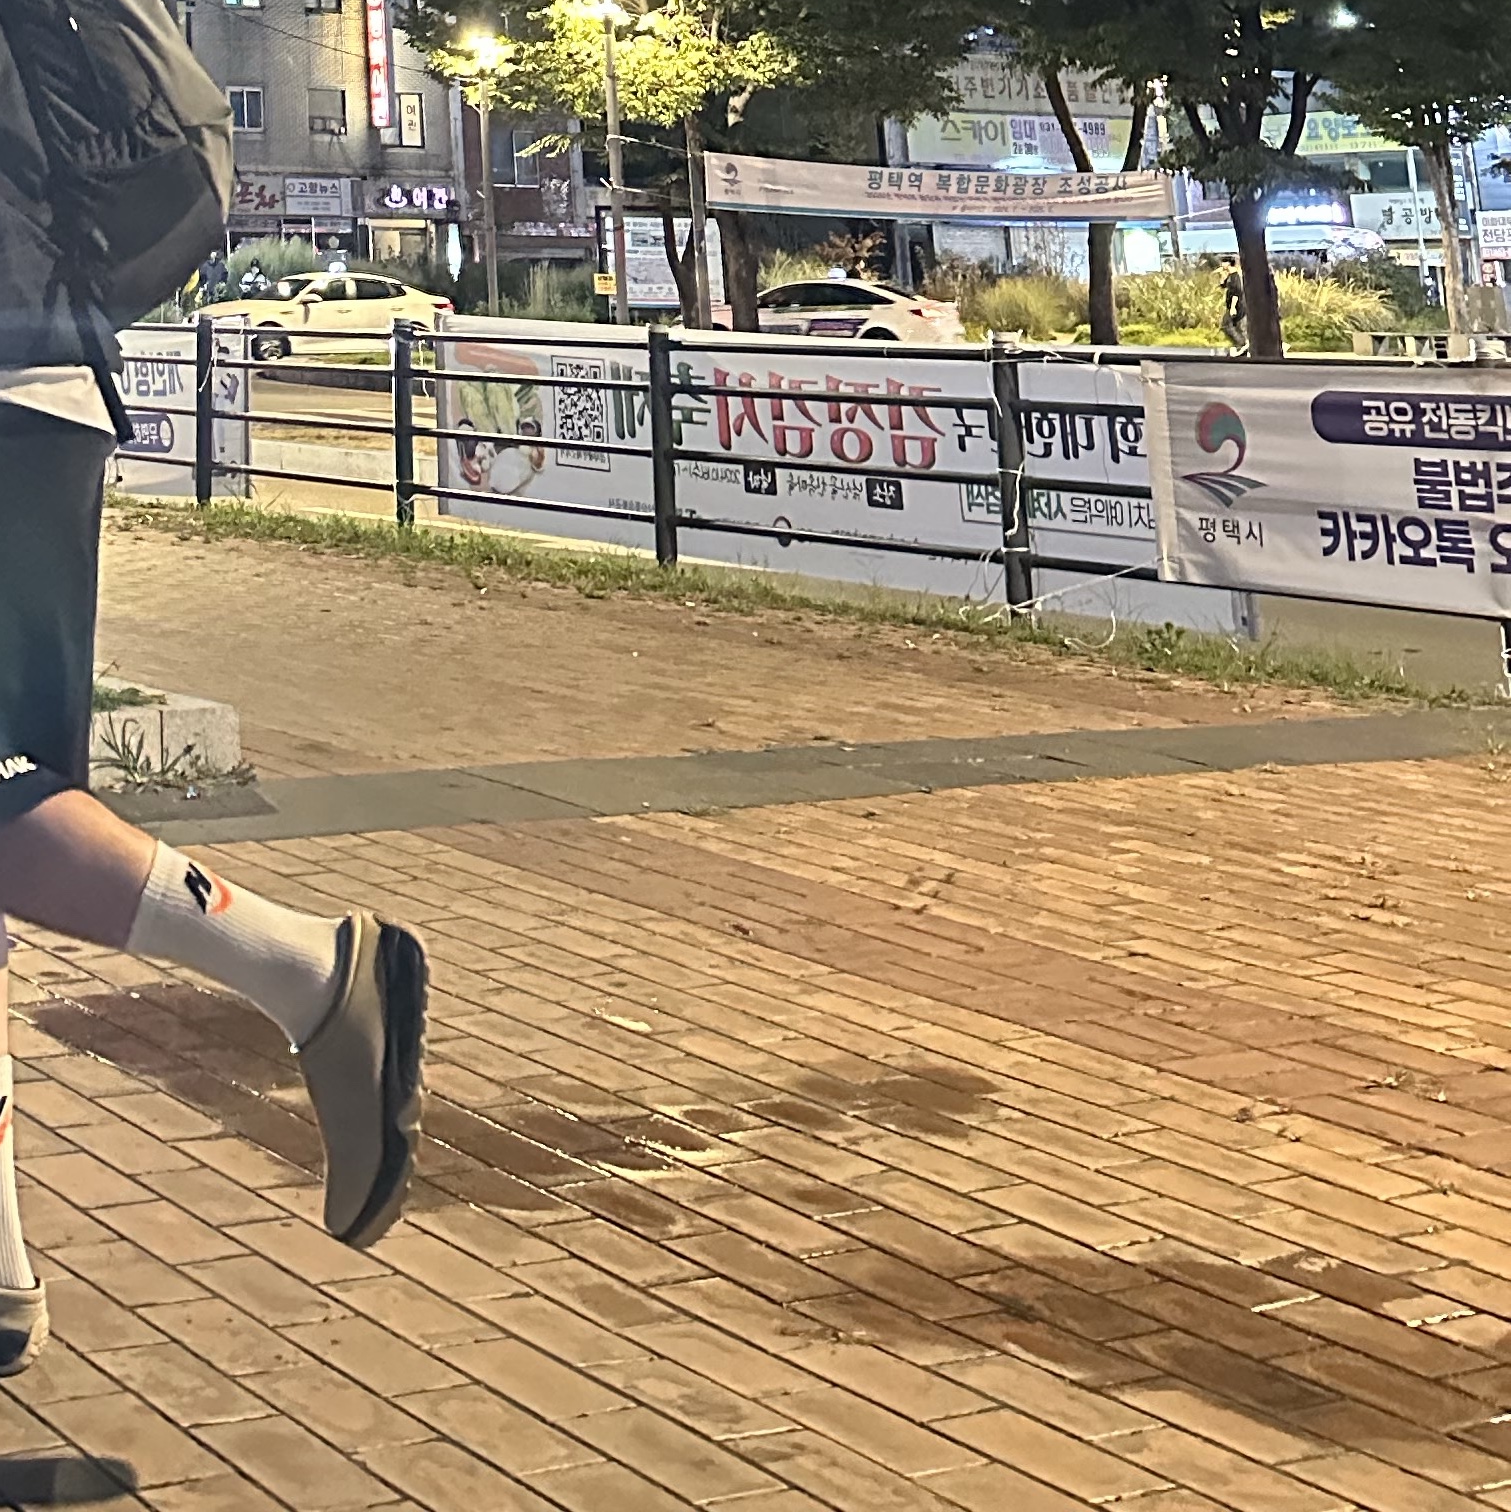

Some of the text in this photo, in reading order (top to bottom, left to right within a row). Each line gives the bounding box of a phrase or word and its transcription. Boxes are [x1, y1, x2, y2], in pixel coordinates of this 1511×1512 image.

[941, 119, 1008, 146] 스카이
[1011, 118, 1037, 141] 임대
[867, 170, 1129, 197] 평택역 복합문화광장 조성공사
[1362, 399, 1511, 443] 공유 전동킥
[1198, 516, 1264, 548] 평택시
[1316, 509, 1475, 574] 카카오톡
